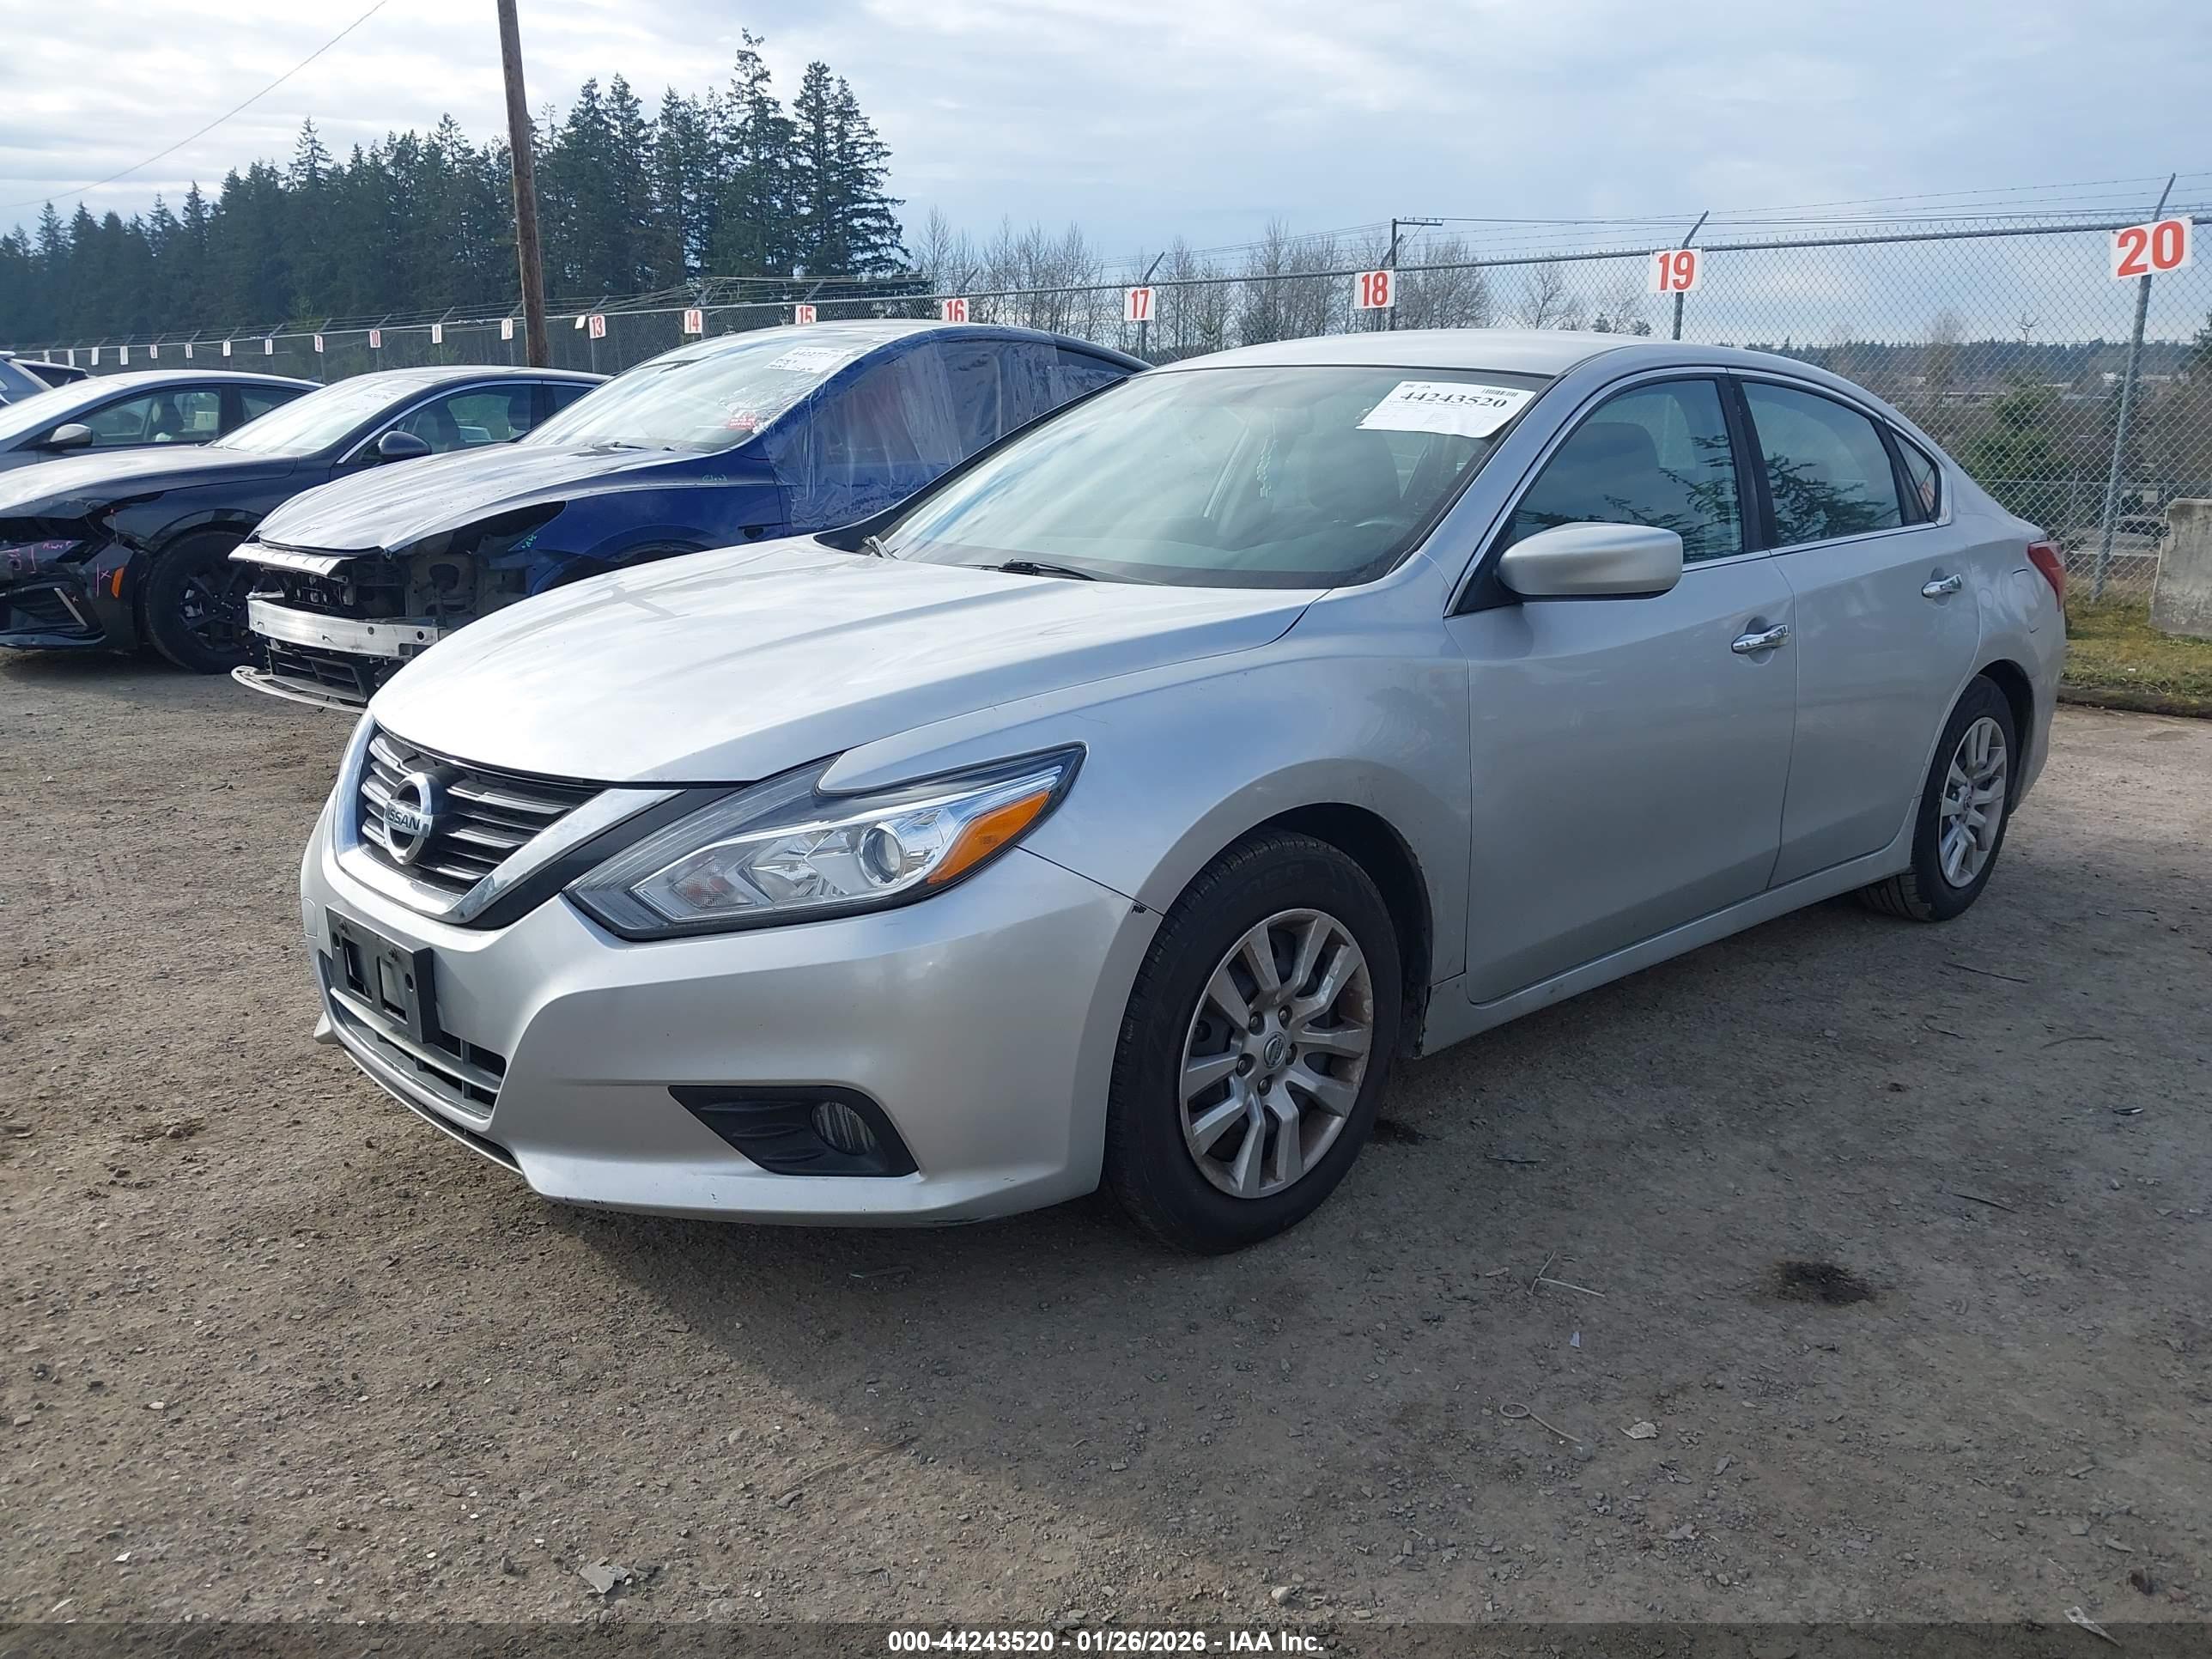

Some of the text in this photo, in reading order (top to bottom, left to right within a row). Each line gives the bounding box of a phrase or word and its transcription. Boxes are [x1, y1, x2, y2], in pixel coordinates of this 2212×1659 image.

[2118, 221, 2185, 276] 20
[1658, 251, 1695, 290] 19
[1361, 271, 1388, 307] 18
[946, 299, 964, 322] 16
[1132, 289, 1150, 319] 17
[687, 311, 700, 331] 14
[799, 306, 812, 324] 15
[503, 320, 511, 337] 12
[592, 317, 603, 337] 13
[371, 331, 379, 347] 10
[1399, 391, 1508, 409] 44243520
